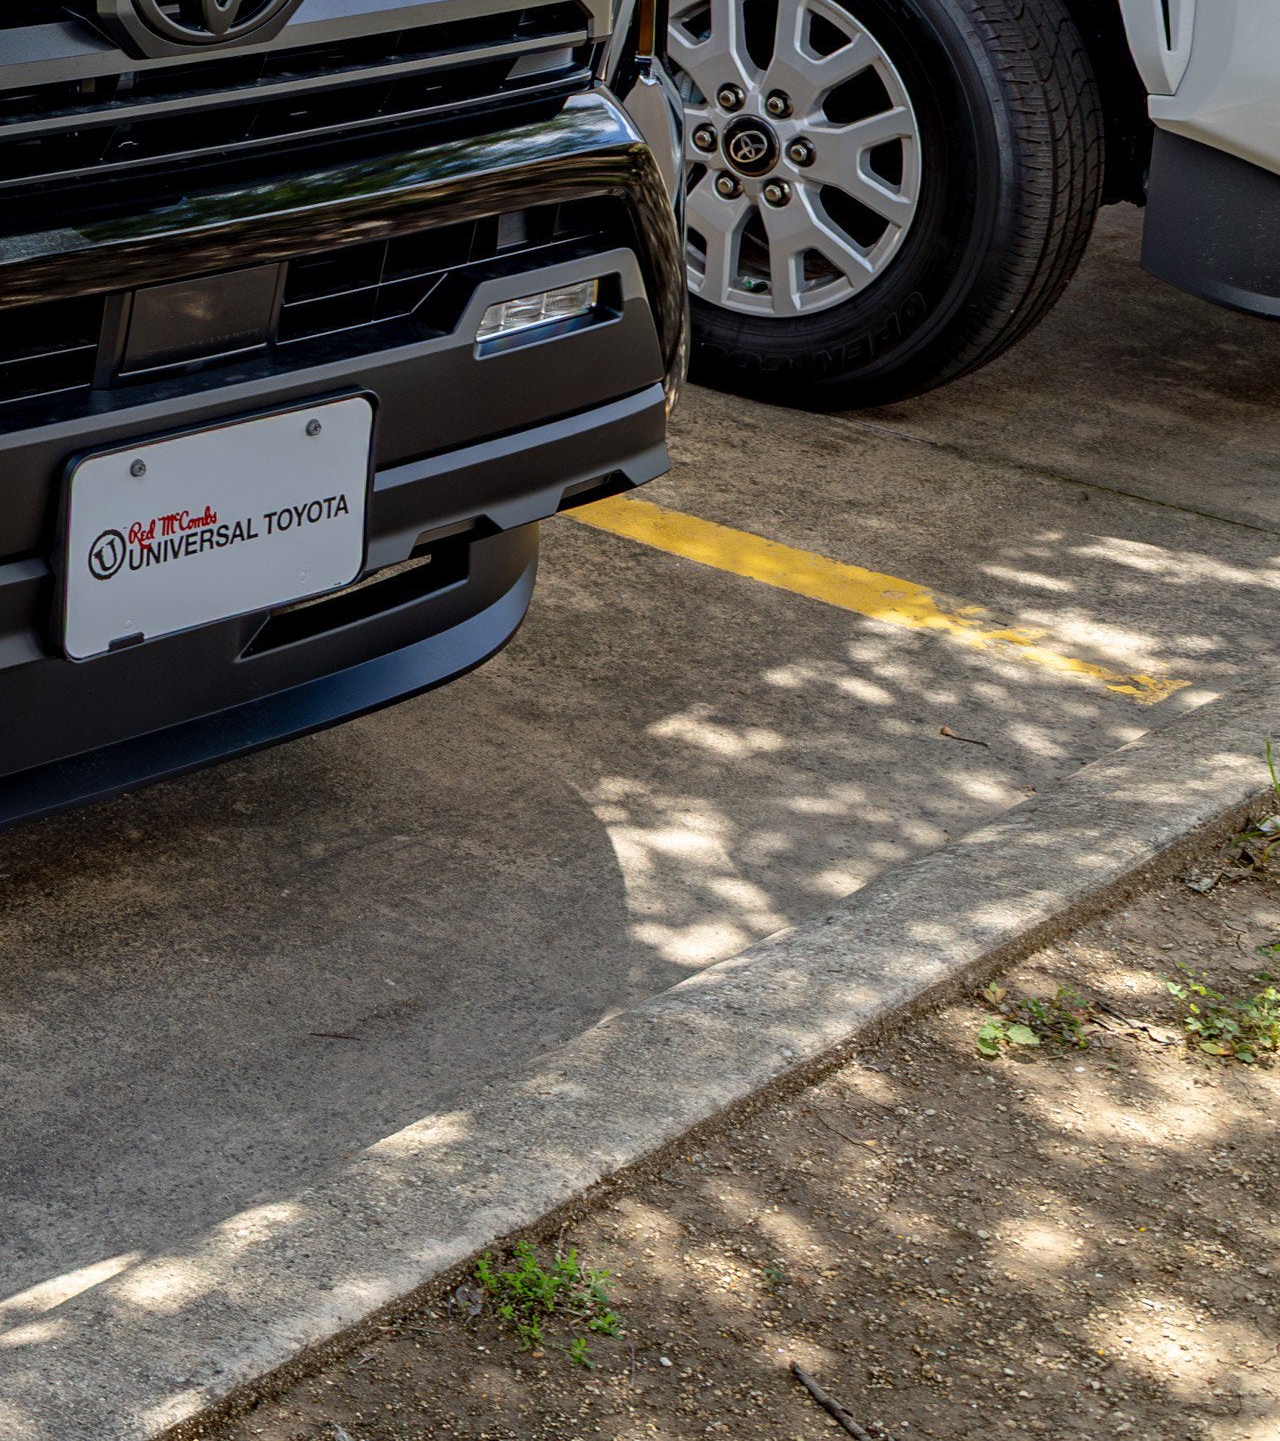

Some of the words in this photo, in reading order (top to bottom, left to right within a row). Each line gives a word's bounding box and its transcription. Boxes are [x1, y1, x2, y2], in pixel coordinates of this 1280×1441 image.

[128, 516, 259, 571] UNIVERSAL
[263, 494, 350, 536] TOYOTA
[128, 517, 156, 549] Red
